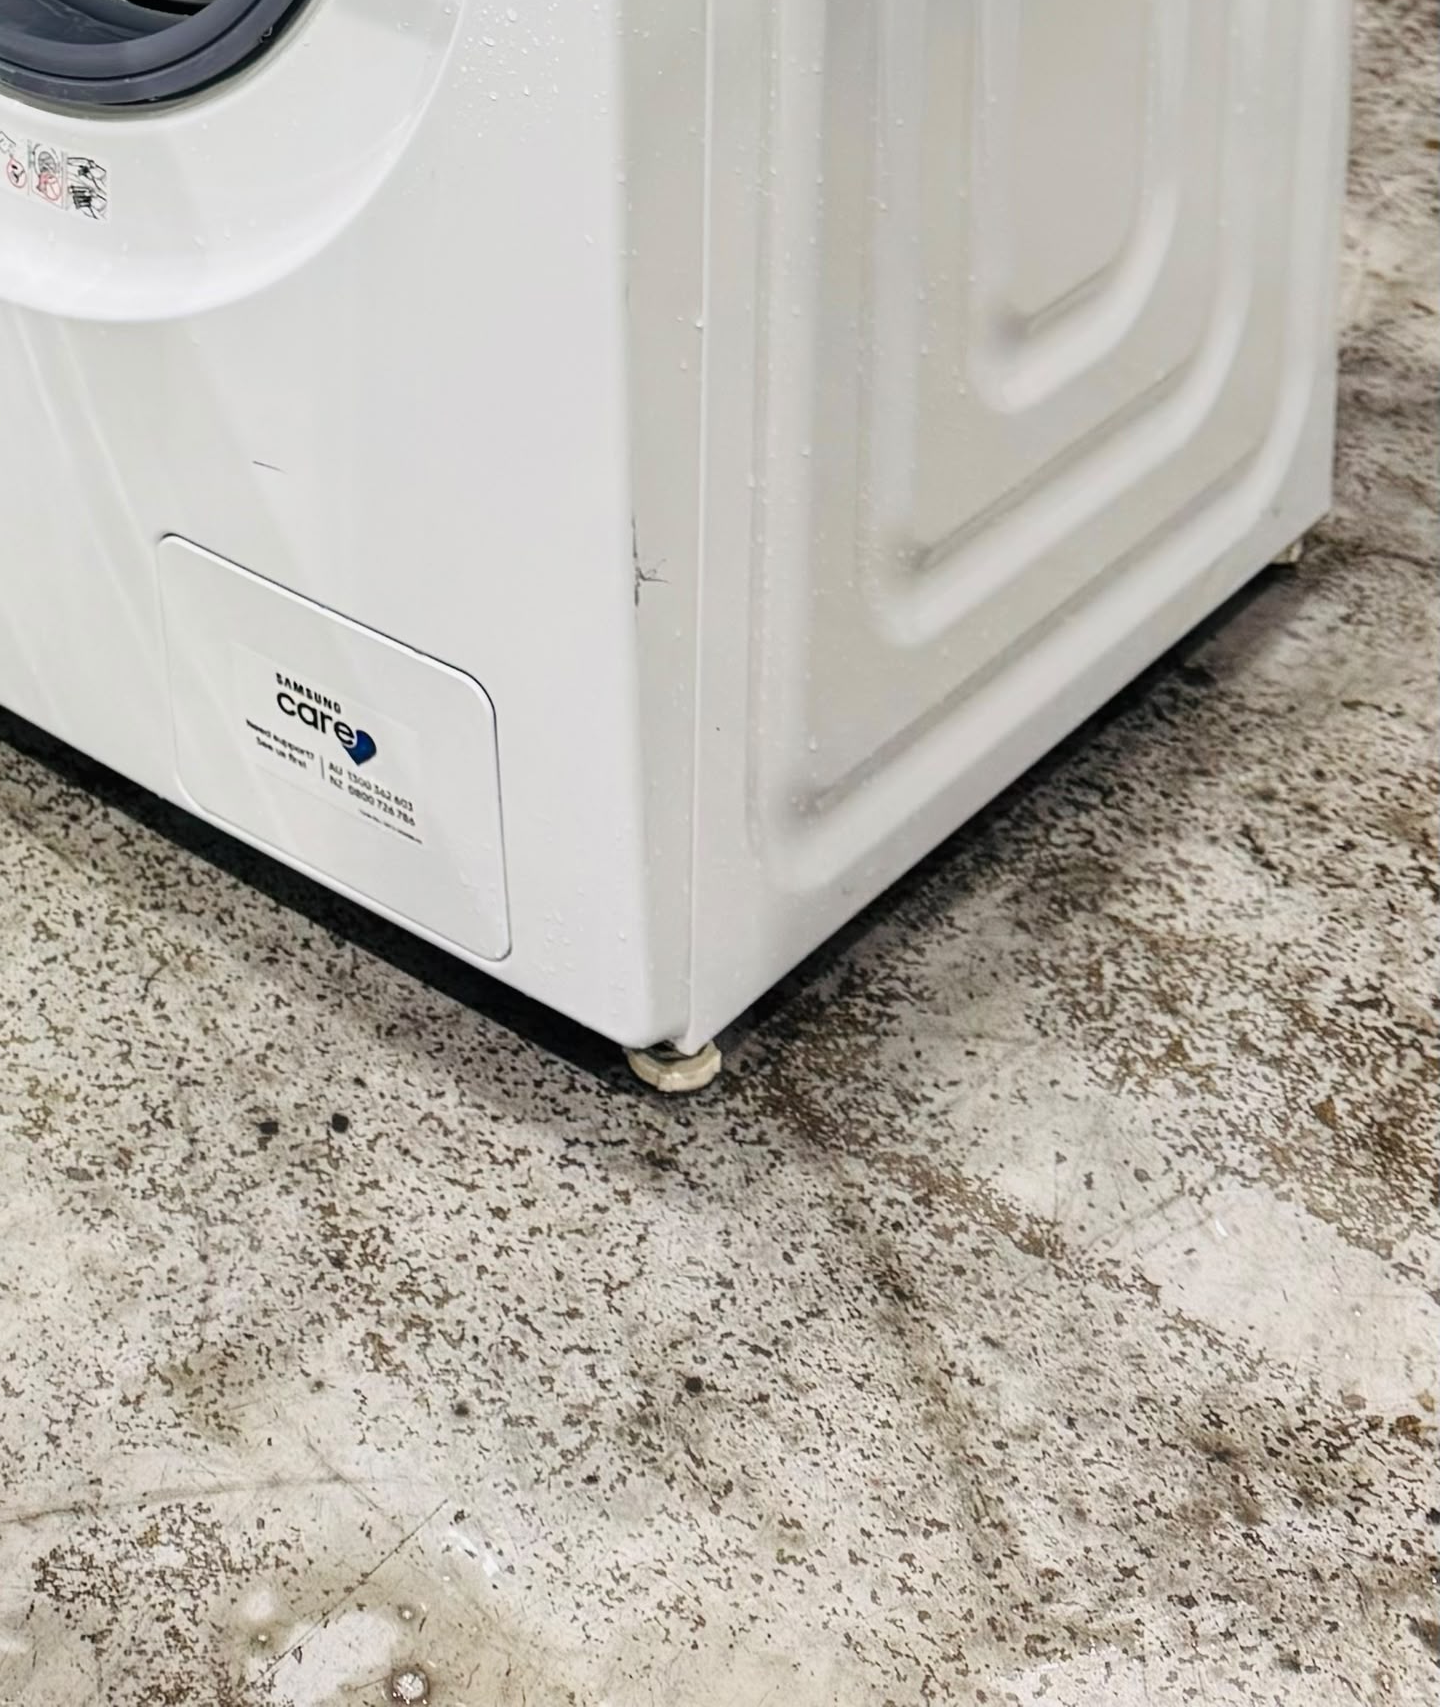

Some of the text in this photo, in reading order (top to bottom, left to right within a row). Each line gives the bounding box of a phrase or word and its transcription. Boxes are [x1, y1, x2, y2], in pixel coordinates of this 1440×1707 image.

[276, 672, 342, 714] SAMSUNG
[276, 692, 355, 746] care
[329, 762, 343, 775] AU
[347, 770, 372, 791] 1300
[329, 775, 343, 790] NZ
[348, 785, 375, 806] 0800
